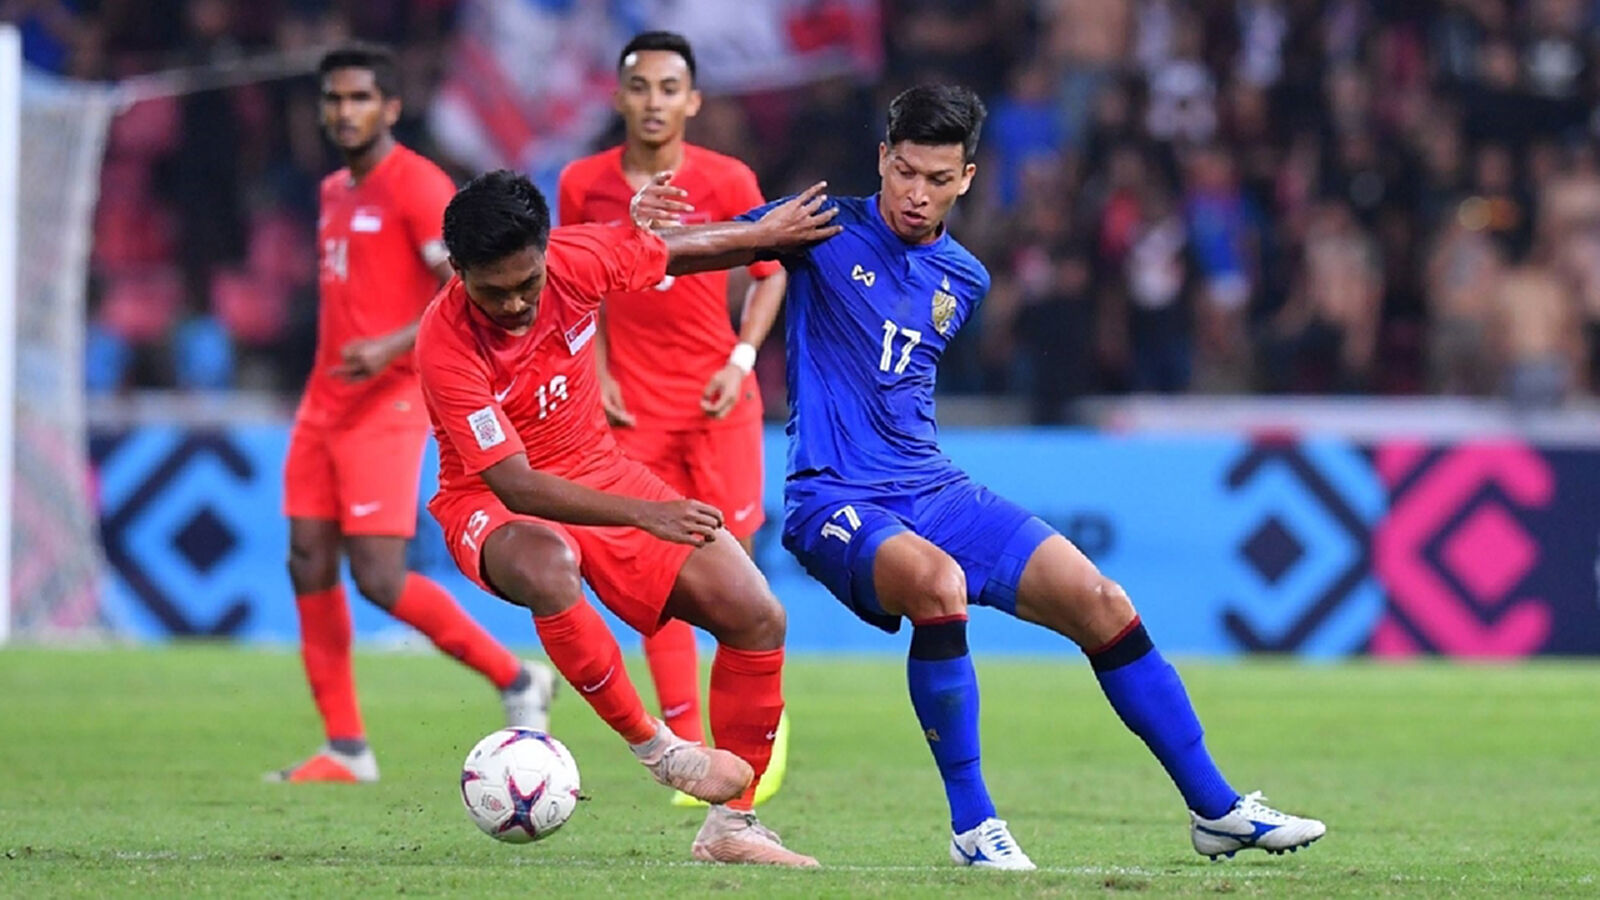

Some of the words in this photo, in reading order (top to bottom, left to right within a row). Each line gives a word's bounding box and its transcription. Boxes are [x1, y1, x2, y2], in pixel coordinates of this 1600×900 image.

[880, 319, 922, 375] 17
[461, 509, 490, 552] 13
[820, 504, 862, 544] 17
